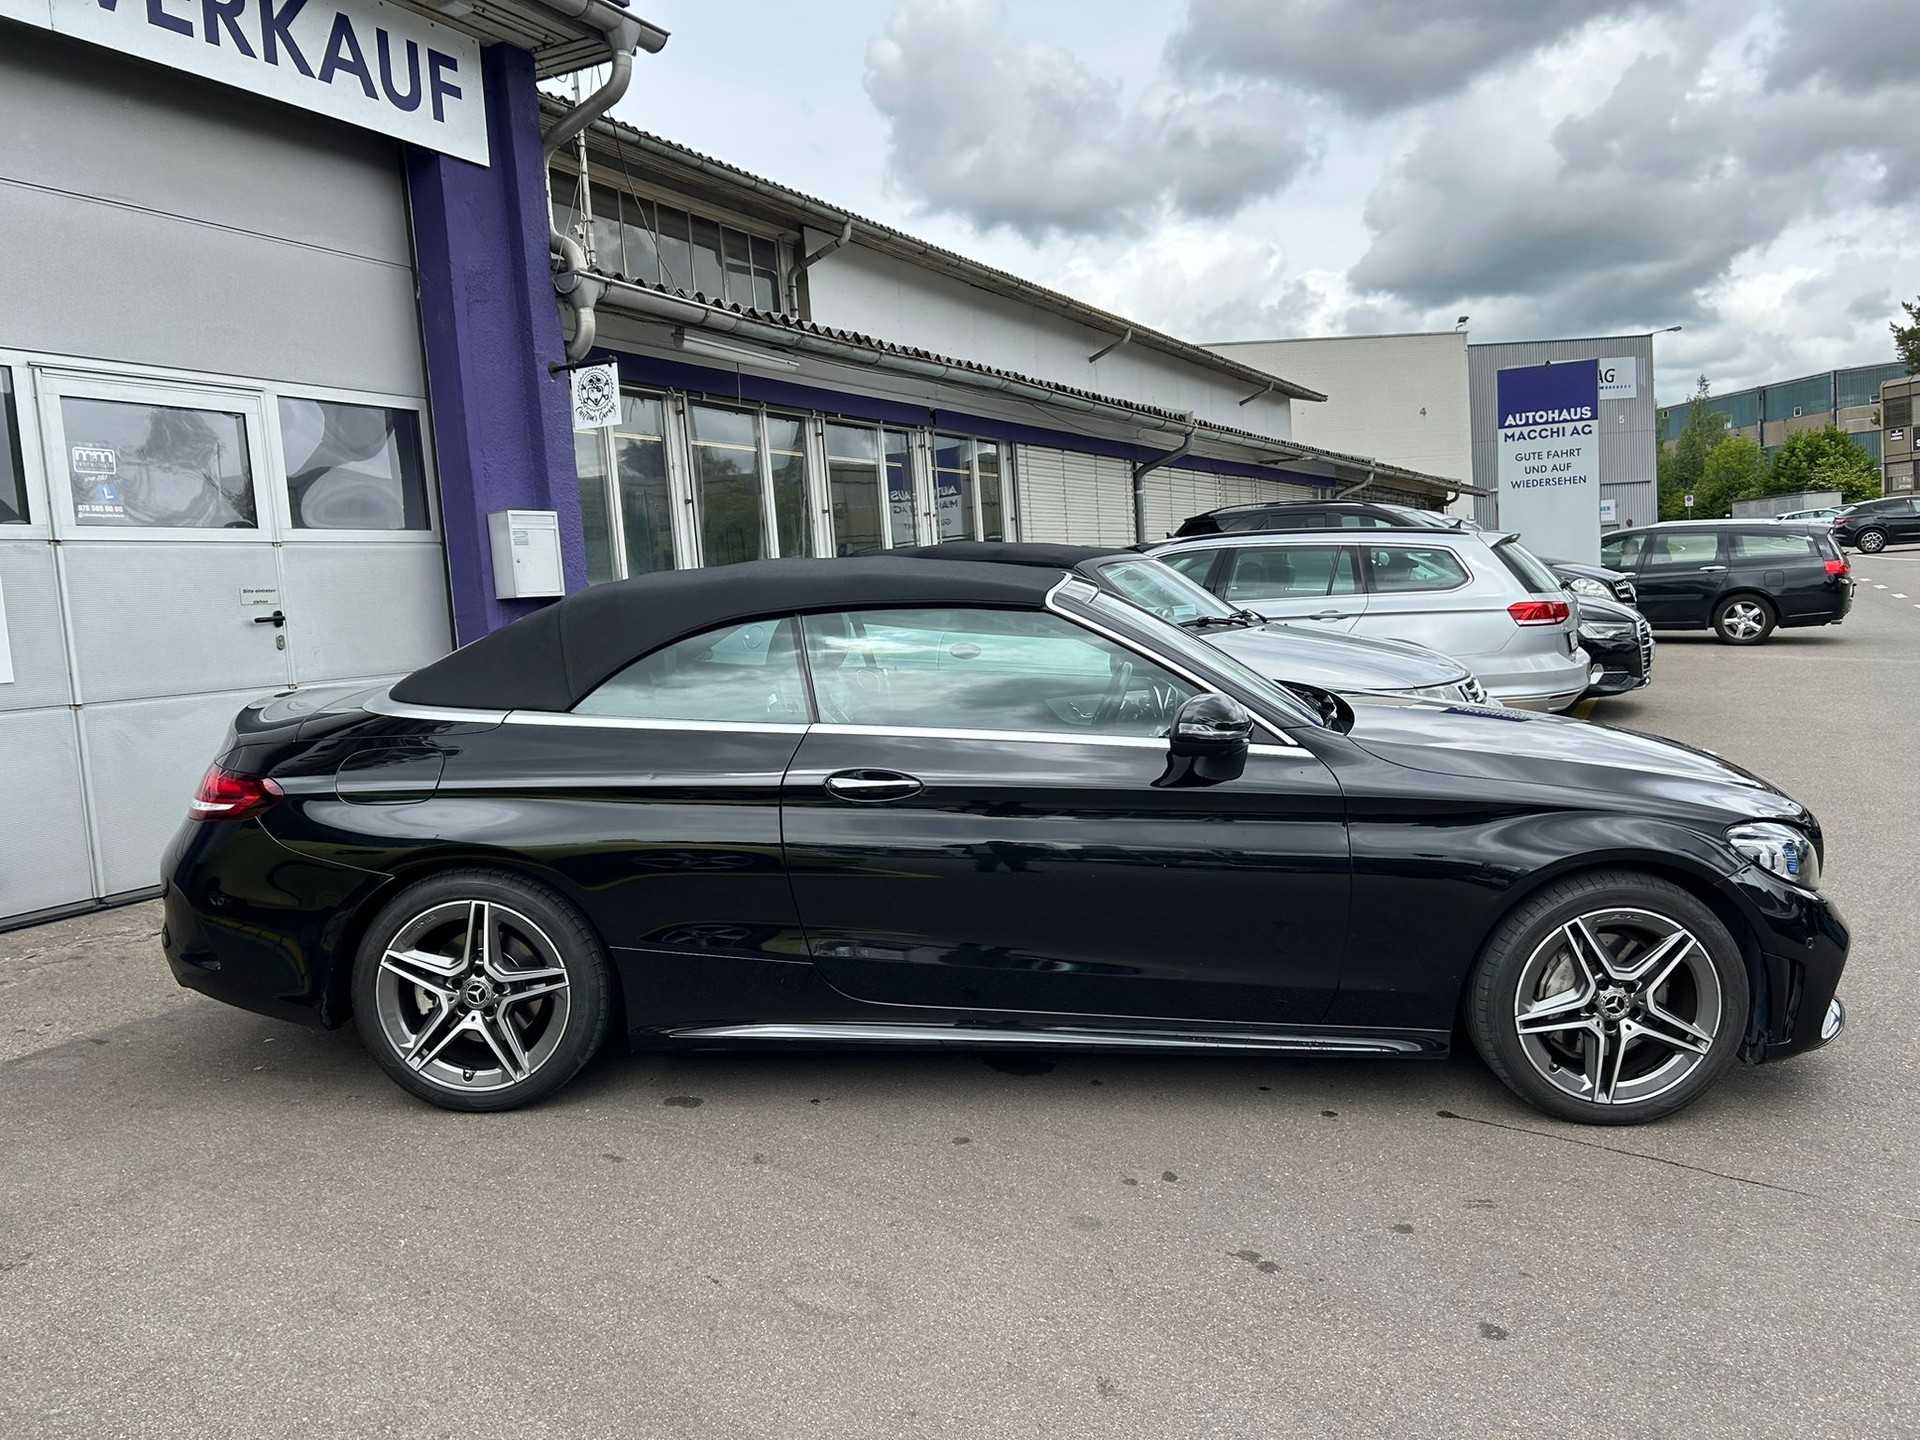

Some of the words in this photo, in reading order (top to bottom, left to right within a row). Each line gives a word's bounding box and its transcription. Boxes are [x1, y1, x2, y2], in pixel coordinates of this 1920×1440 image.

[96, 0, 462, 123] RKAUF
[1504, 407, 1592, 426] AUTOHAUS
[1618, 414, 1625, 424] 5
[1504, 426, 1566, 442] MACCHI
[1570, 424, 1593, 437] AG
[1514, 451, 1543, 462] GUTE
[1546, 447, 1582, 460] FAHRT
[1524, 464, 1548, 475] UND
[1550, 462, 1572, 473] AUF
[1510, 475, 1587, 489] WIEDERSEHEN
[103, 487, 114, 499] L
